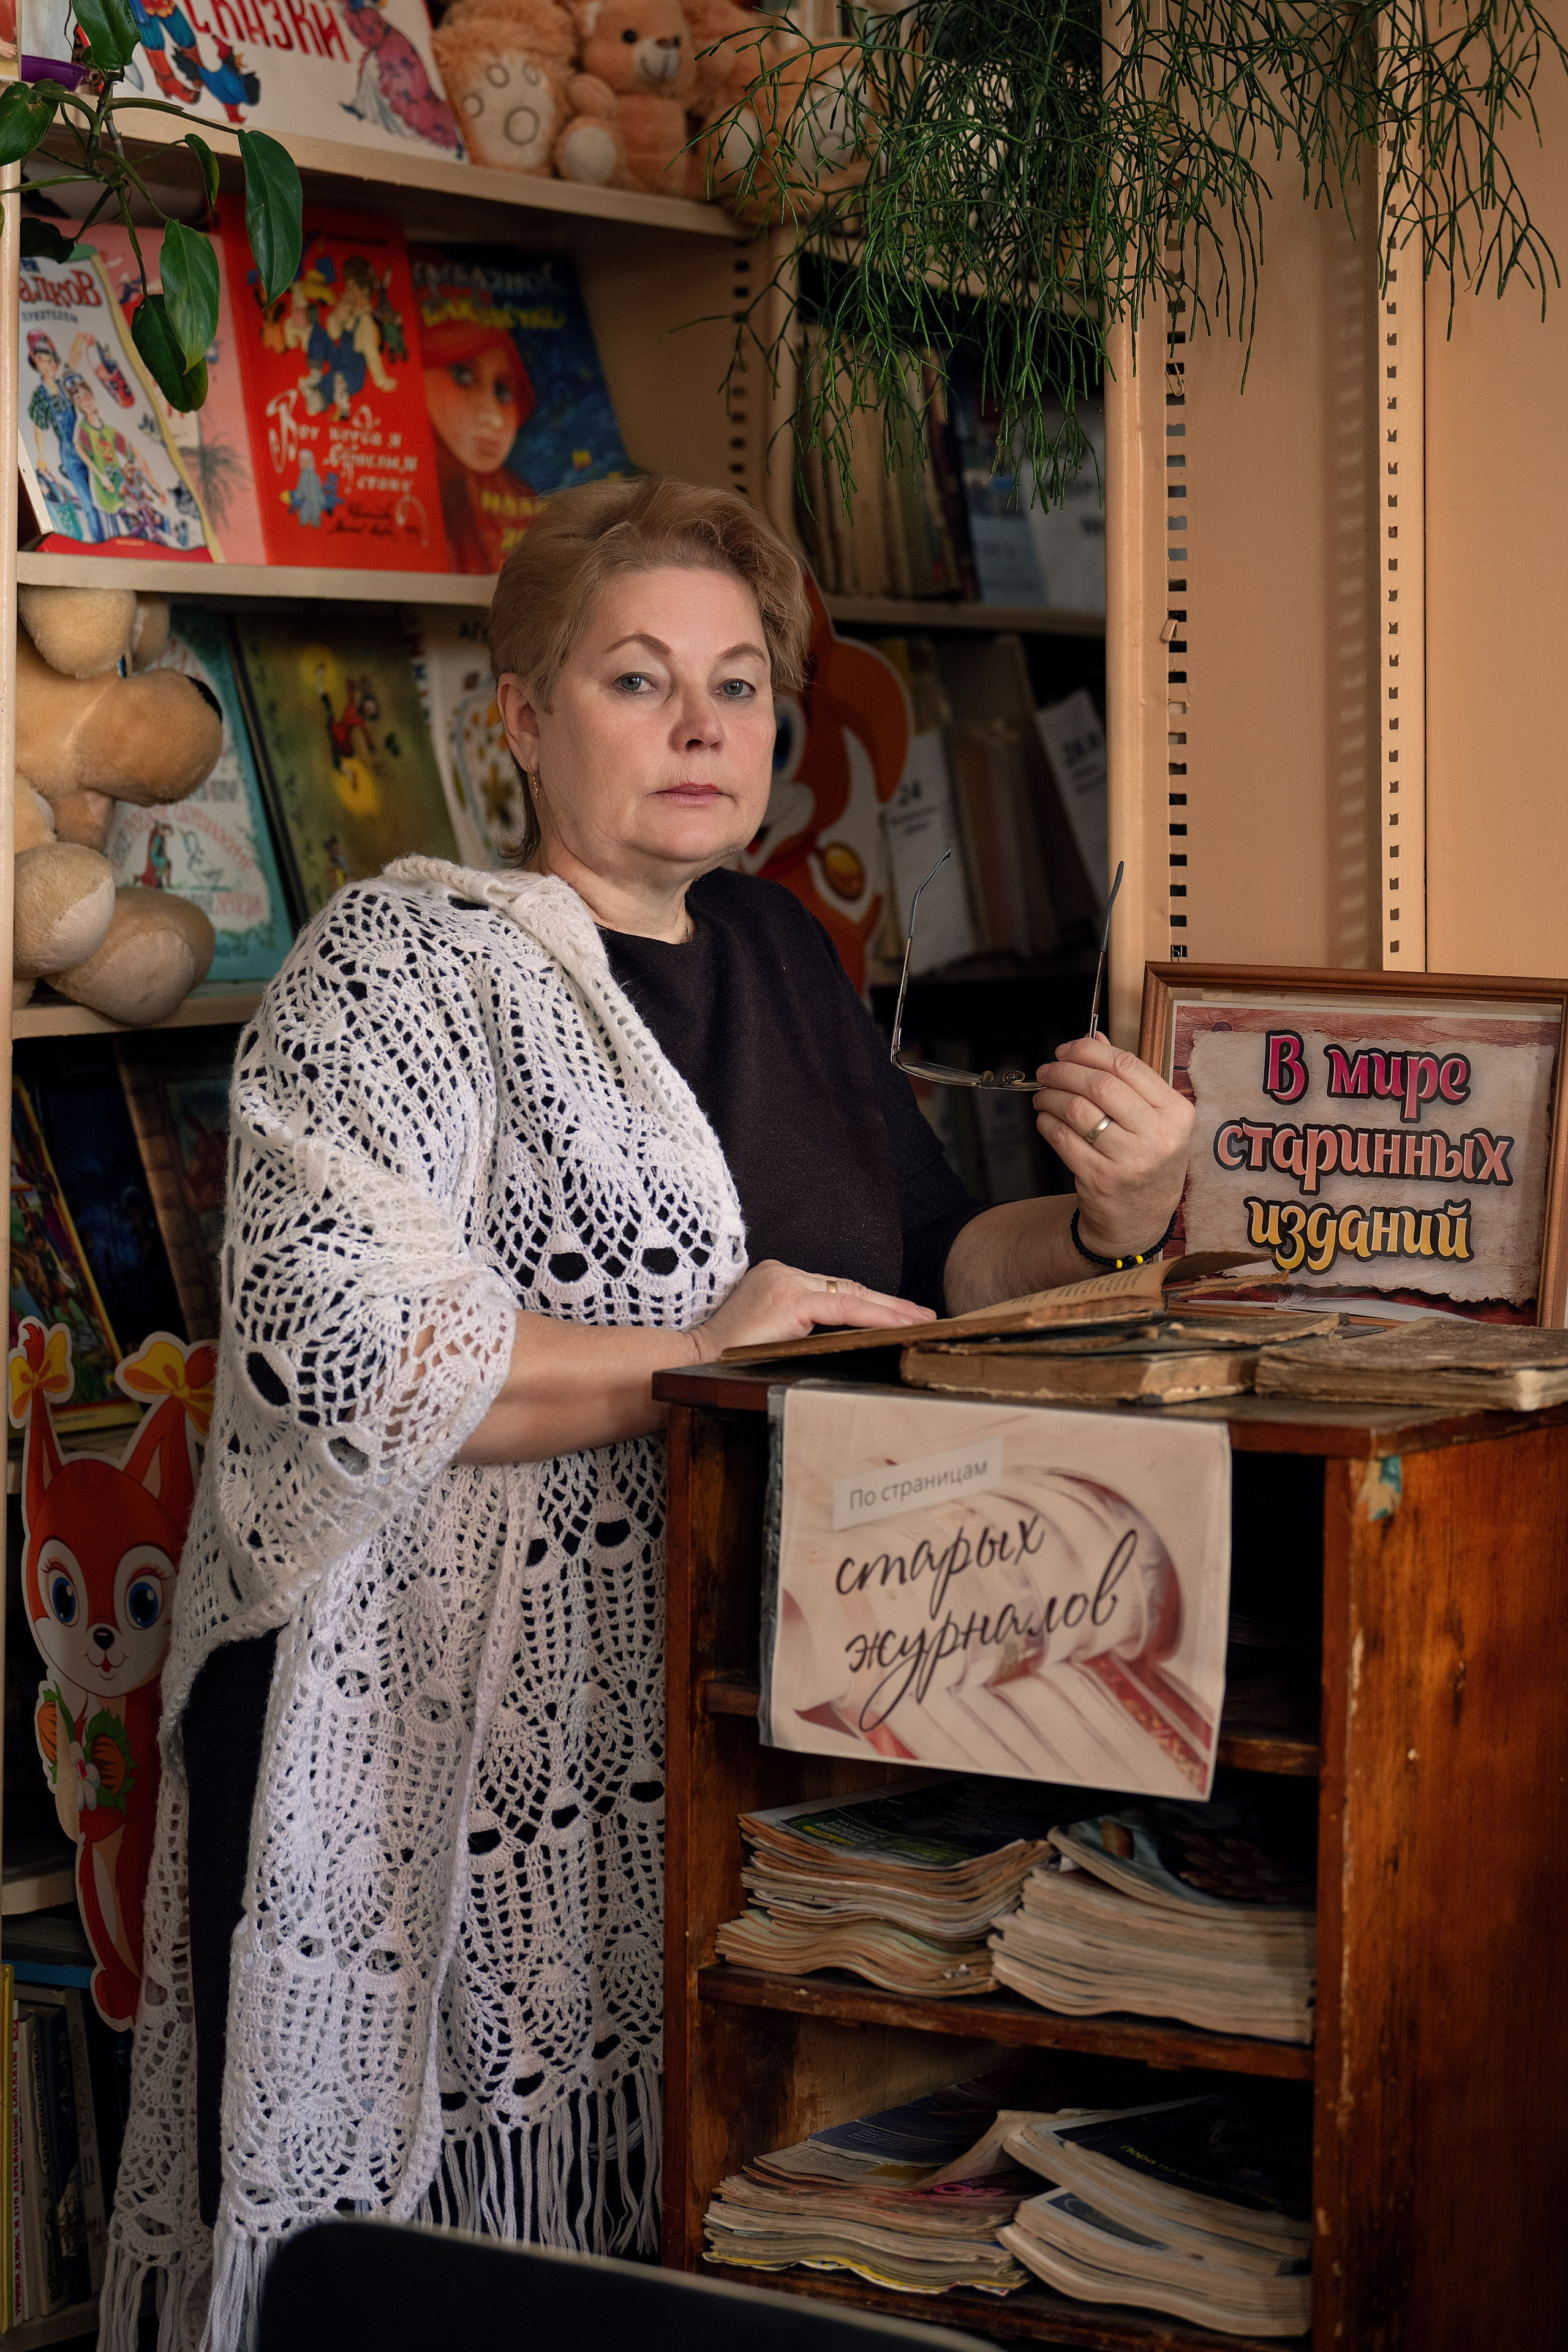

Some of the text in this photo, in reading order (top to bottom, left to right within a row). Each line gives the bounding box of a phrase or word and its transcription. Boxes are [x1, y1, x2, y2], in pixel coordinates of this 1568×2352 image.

[1263, 1030, 1472, 1123] В мире
[1213, 1118, 1515, 1195] старинных
[1243, 1196, 1474, 1275] изданий
[848, 1459, 989, 1511] По страницам
[835, 1514, 1046, 1620] старых
[845, 1529, 1138, 1733] журналов
